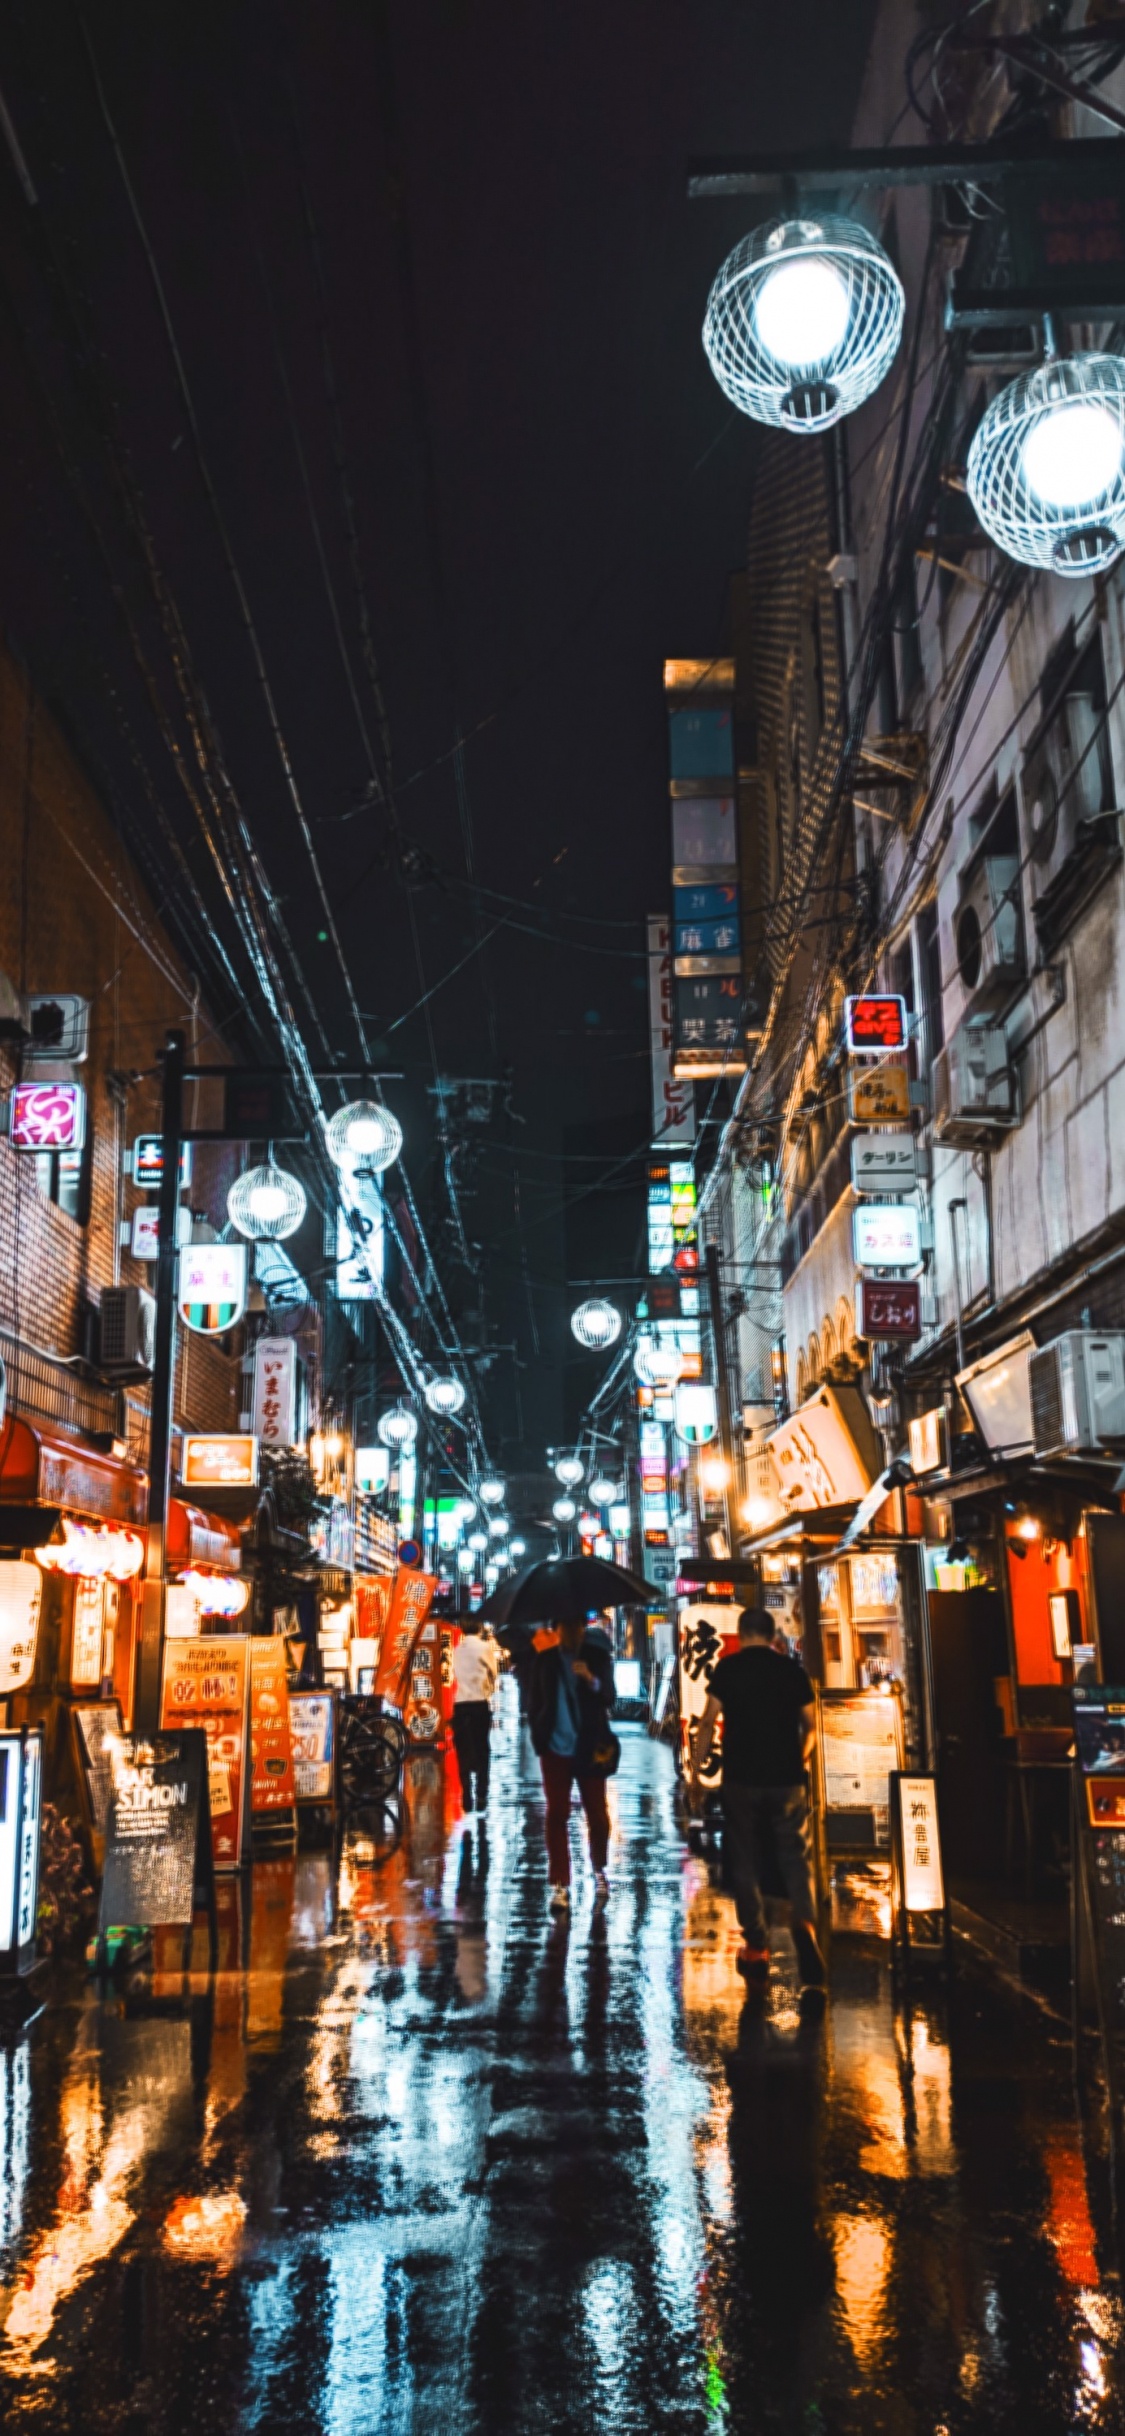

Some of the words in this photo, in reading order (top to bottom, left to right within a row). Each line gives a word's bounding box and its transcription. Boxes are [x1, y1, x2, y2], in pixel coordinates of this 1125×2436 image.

[680, 926, 735, 950] 麻雀
[682, 1017, 736, 1042] 喫茶
[862, 1151, 912, 1166] ダーリン
[261, 1360, 283, 1439] いまむら
[411, 1646, 434, 1700] 焼鳥
[115, 1767, 155, 1789] BAR
[114, 1781, 188, 1811] SIMON
